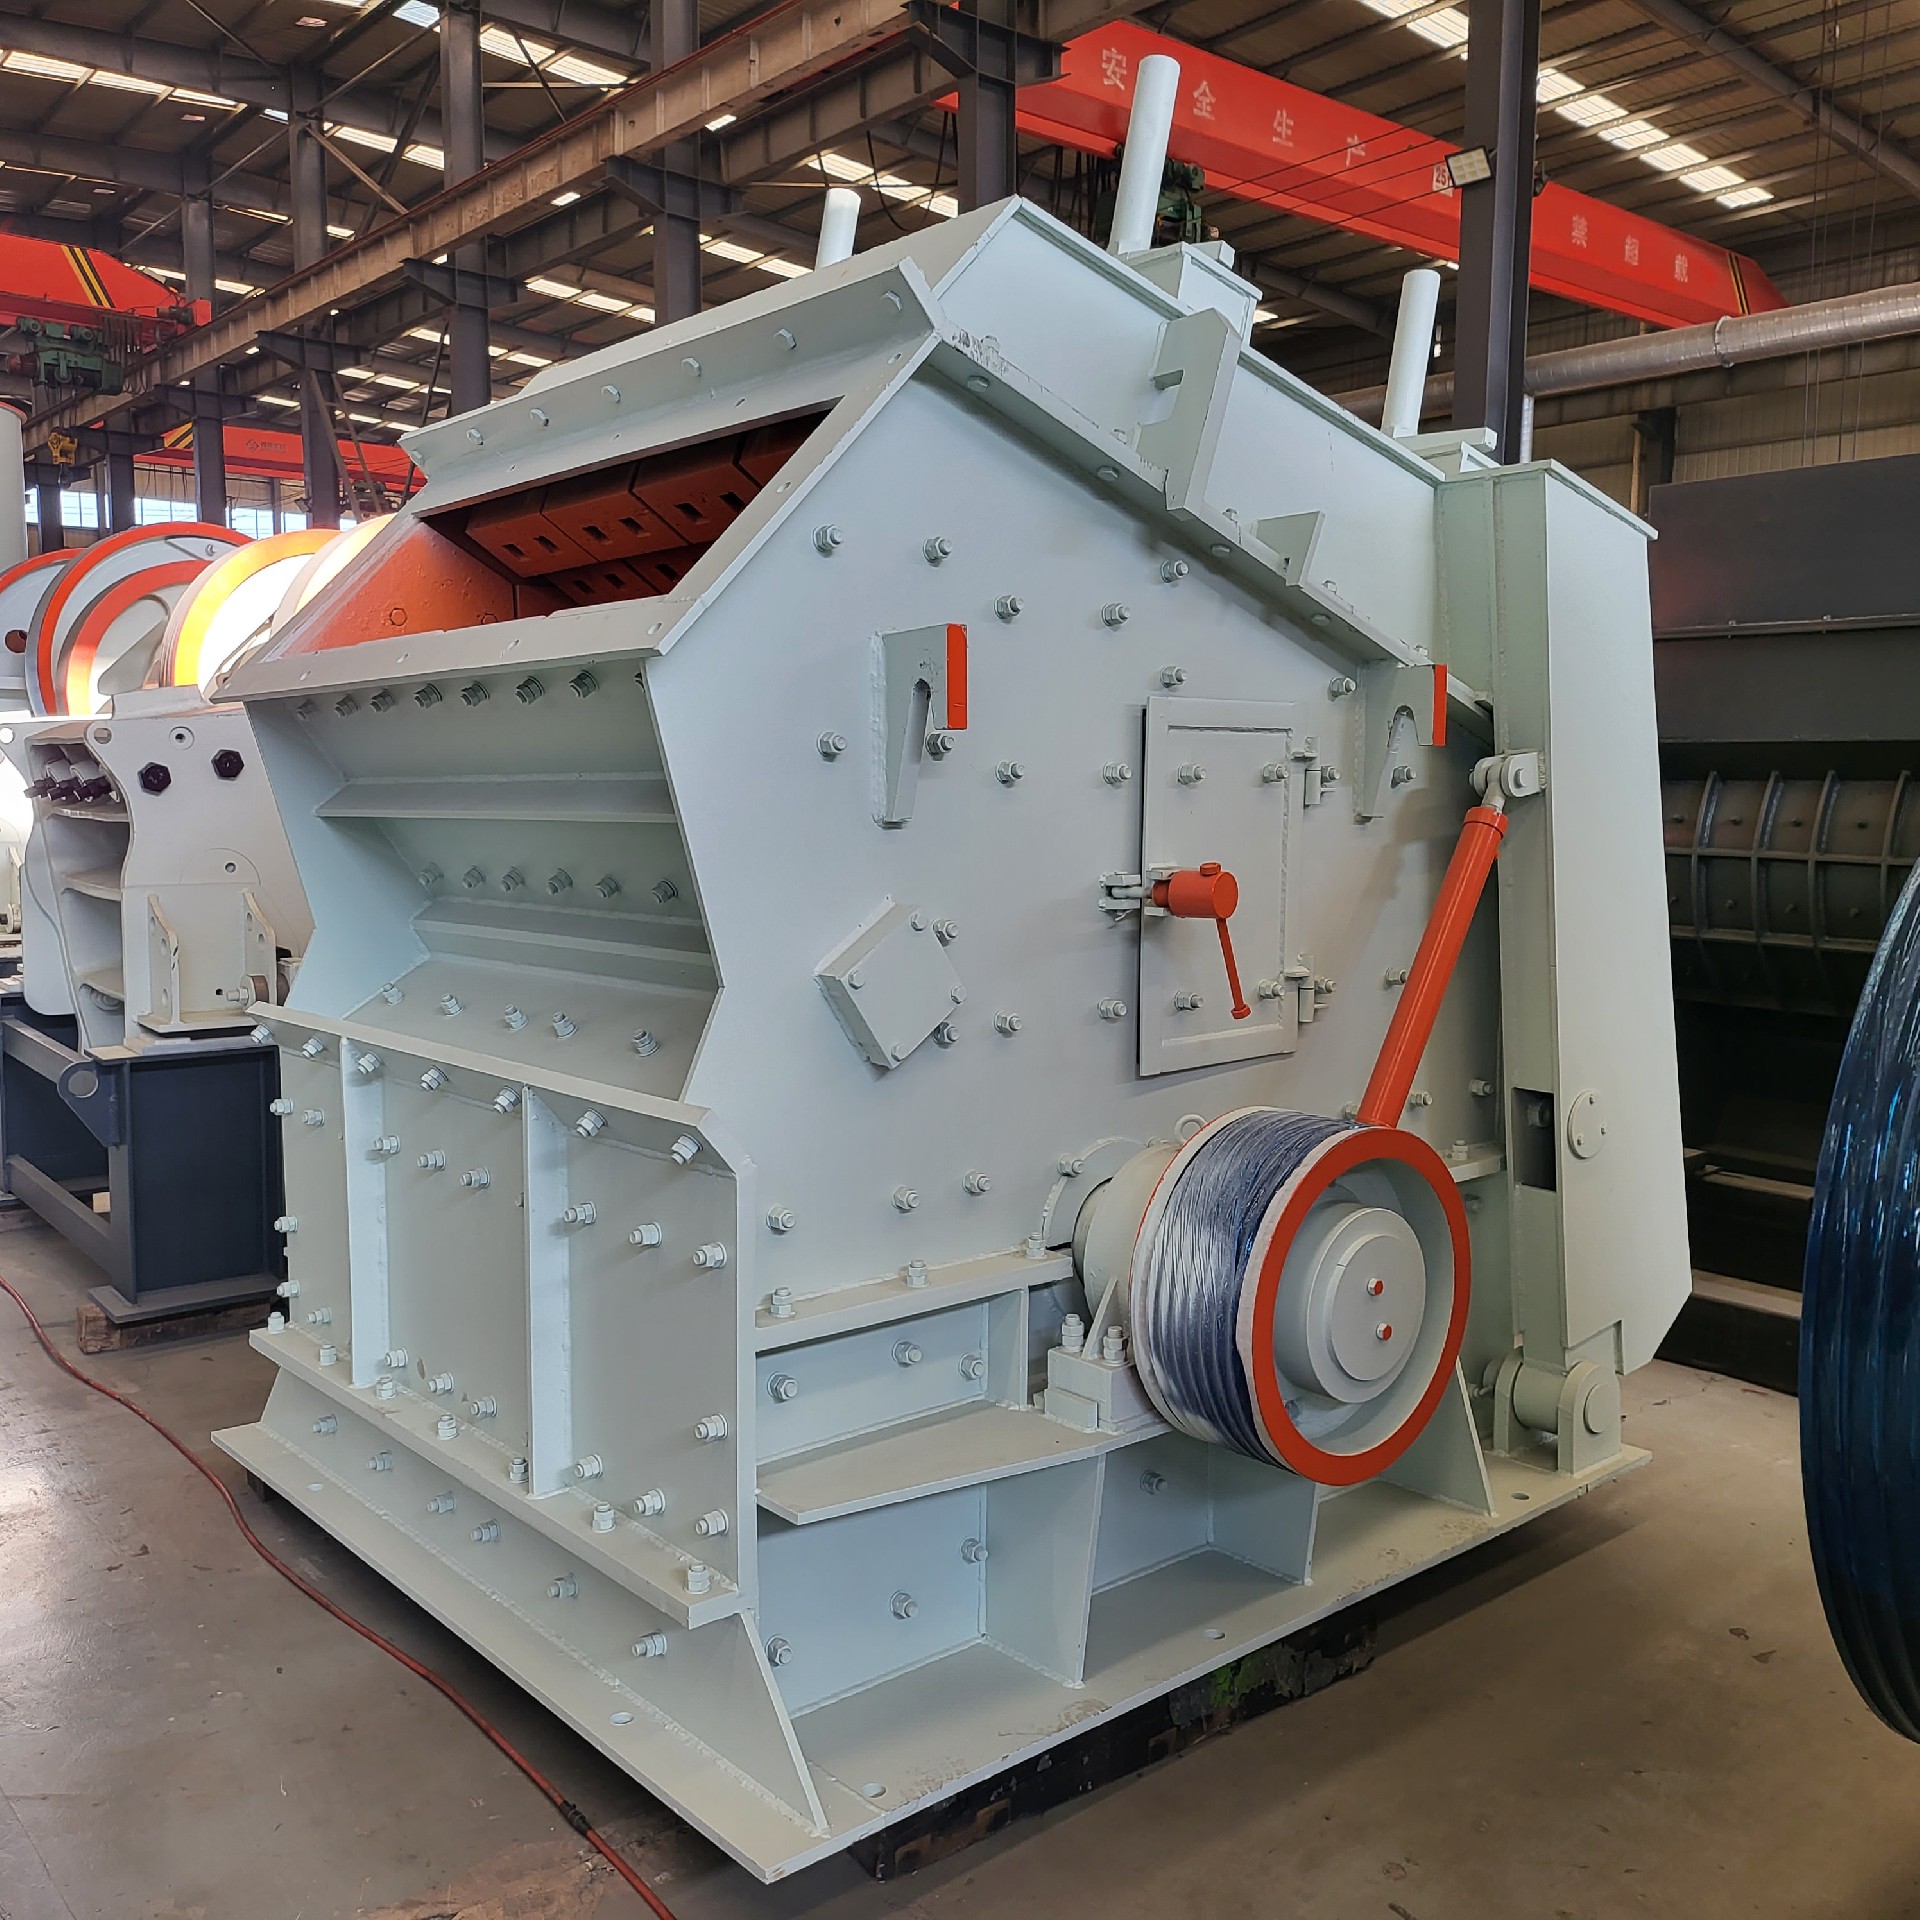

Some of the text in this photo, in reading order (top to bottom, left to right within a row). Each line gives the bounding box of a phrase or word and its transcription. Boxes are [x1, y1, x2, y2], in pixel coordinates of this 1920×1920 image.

[1102, 48, 1365, 166] 安全生产
[1435, 166, 1451, 187] 25
